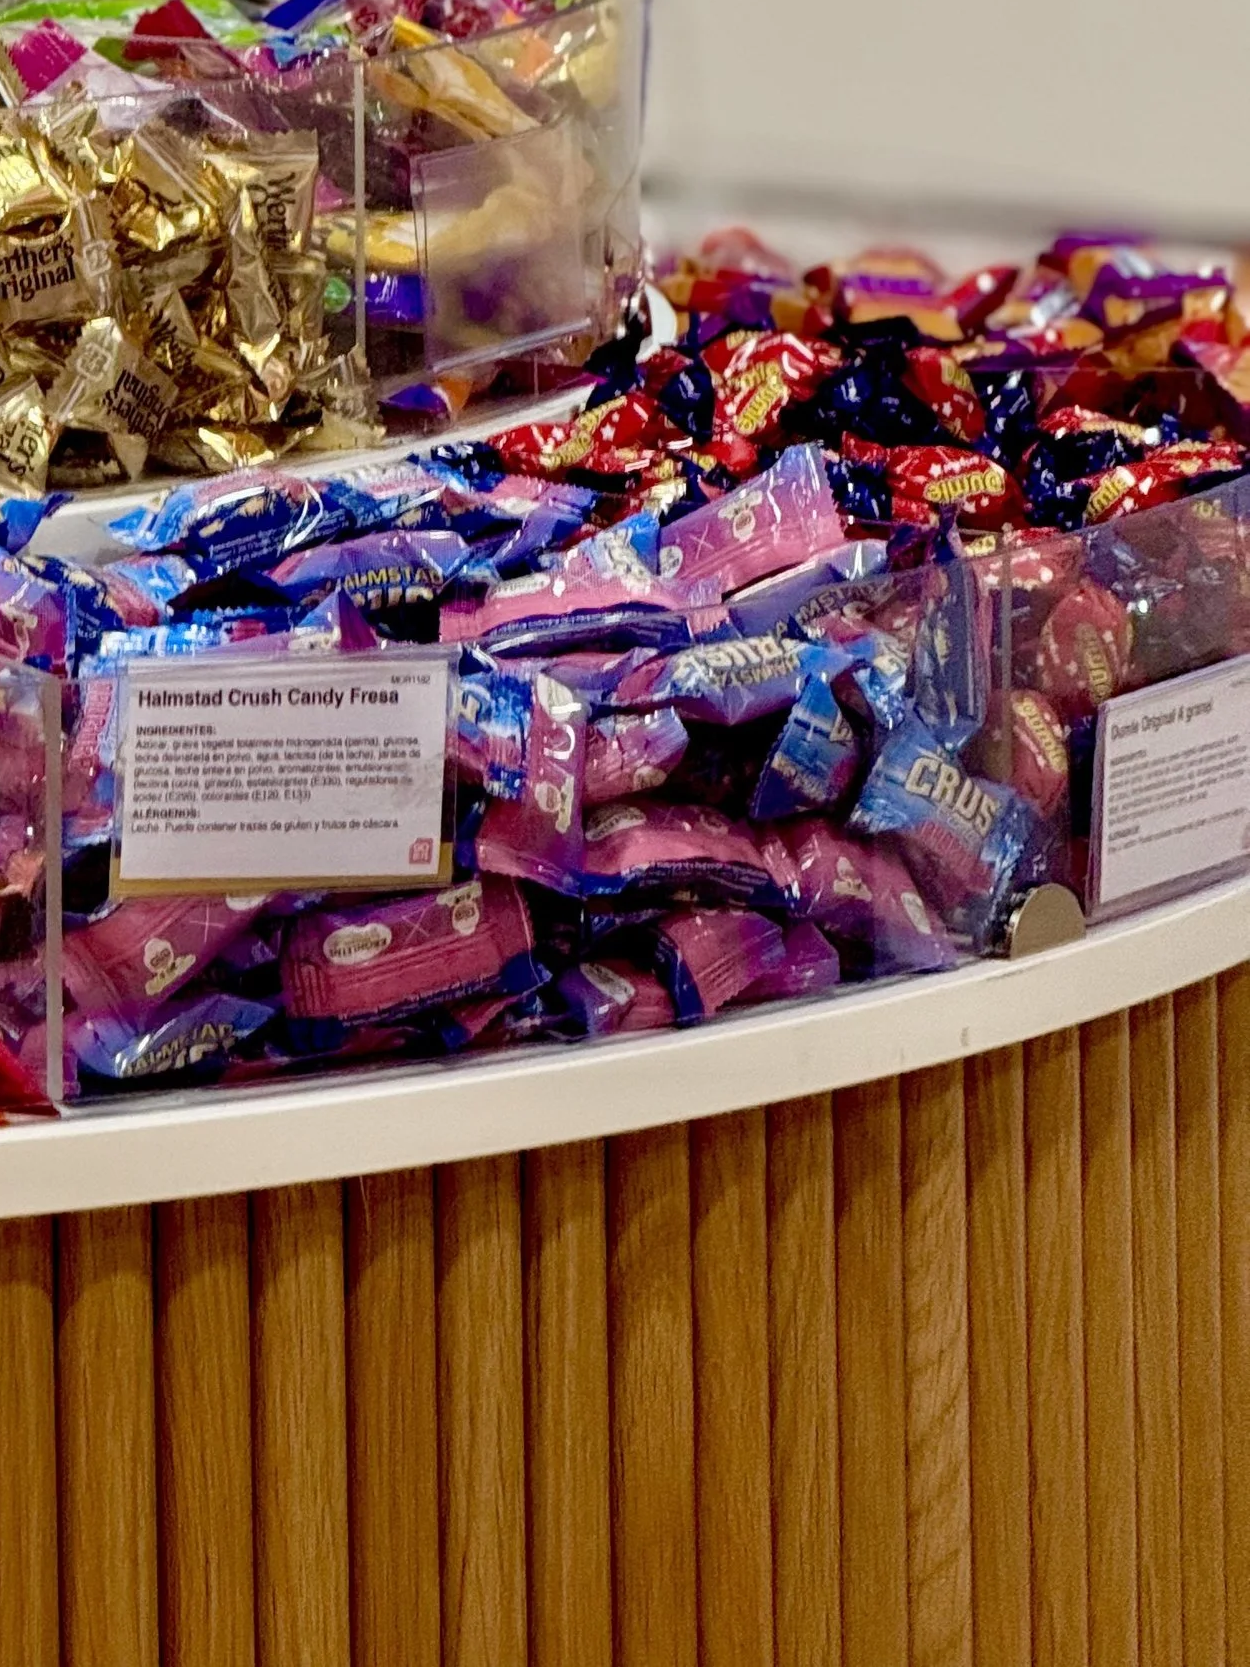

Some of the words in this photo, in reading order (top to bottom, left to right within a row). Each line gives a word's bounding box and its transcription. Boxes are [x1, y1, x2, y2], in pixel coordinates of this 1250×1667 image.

[923, 467, 1005, 506] Dumle
[138, 688, 223, 709] Halmstad
[228, 687, 283, 708] Crush
[287, 686, 344, 710] Candy
[349, 685, 399, 706] Fresa
[905, 755, 1001, 838] CRUS
